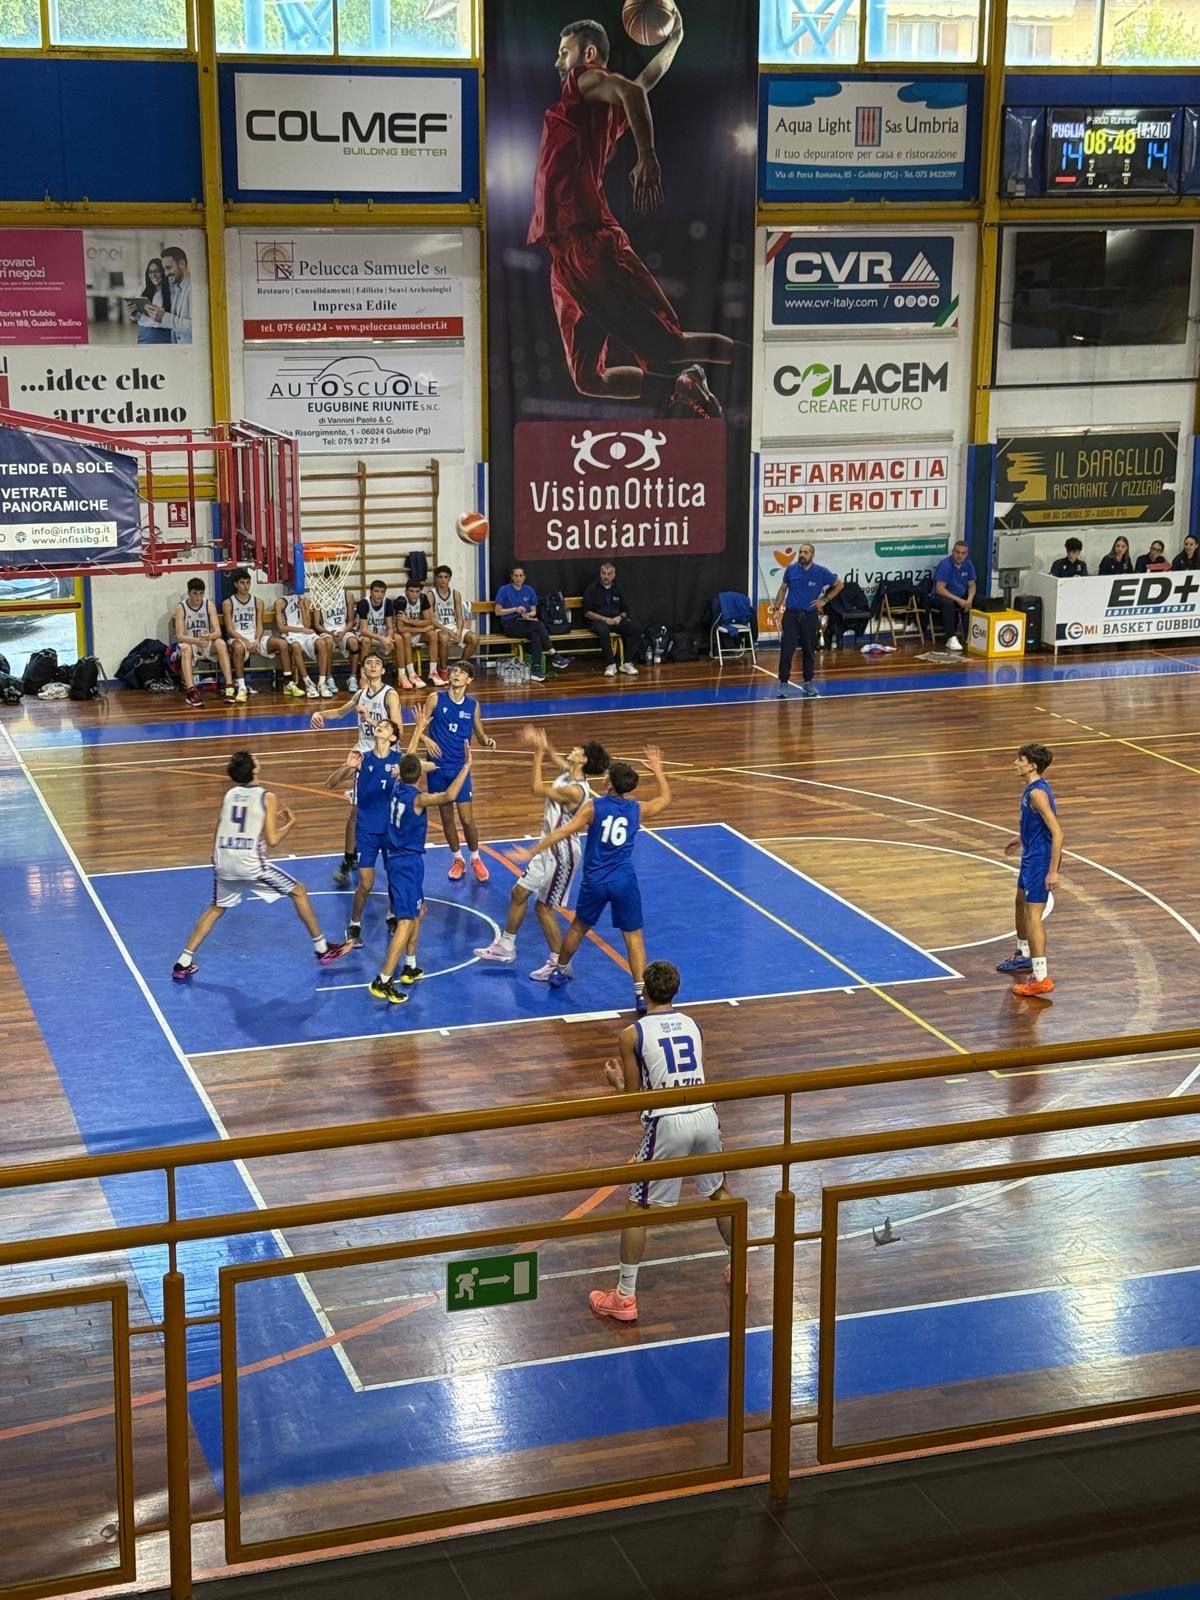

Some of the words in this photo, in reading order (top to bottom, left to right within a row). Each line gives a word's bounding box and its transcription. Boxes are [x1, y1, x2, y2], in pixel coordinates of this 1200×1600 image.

[246, 109, 447, 144] COLMEF
[775, 118, 812, 135] Aqua
[817, 117, 852, 135] Light
[885, 119, 902, 133] Sas
[906, 116, 959, 133] Umbria
[1052, 122, 1084, 138] PUGLIA
[1139, 123, 1169, 138] LAZIO
[1083, 128, 1136, 155] 08:48
[343, 147, 398, 156] BUILDING
[400, 148, 447, 157] BETTER
[784, 150, 800, 159] tuo
[803, 149, 854, 161] depuratore
[857, 151, 871, 161] per
[875, 150, 894, 159] casa
[897, 151, 902, 159] e
[905, 149, 958, 159] ristorazione
[1062, 142, 1083, 170] 14
[1147, 142, 1168, 170] 14
[775, 171, 786, 179] Via
[8, 267, 46, 281] negozi
[299, 259, 359, 276] Pelucca
[364, 259, 429, 276] Samuele
[434, 265, 447, 276] Srl
[786, 251, 893, 283] CVR
[257, 286, 290, 295] Restauro
[294, 286, 351, 295] Consolidamenti
[356, 286, 384, 295] Edilizia
[388, 286, 407, 295] Scavi
[409, 286, 452, 295] Archeologici
[29, 309, 57, 318] Gubbio
[313, 300, 362, 314] Impresa
[366, 300, 397, 312] Edile
[3, 319, 15, 328] km
[31, 319, 57, 328] Gualdo
[260, 323, 275, 333] tel.
[277, 322, 293, 333] 075
[295, 322, 327, 333] 602424
[335, 320, 448, 334] www.peluccasamuelesrl.it
[115, 367, 166, 391] che
[773, 361, 949, 397] COLACEM
[269, 379, 439, 397] AUTOSCUOLE
[53, 401, 188, 424] arredano
[307, 401, 371, 413] EUGUBINE
[373, 400, 420, 412] RIUNITE
[420, 403, 440, 412] S.N.C.
[798, 398, 857, 414] CREARE
[862, 397, 923, 412] FUTURO
[319, 417, 326, 425] di
[327, 416, 355, 425] Vannini
[357, 416, 377, 424] Paolo
[378, 416, 385, 424] &
[295, 427, 349, 438] Risorgimento,
[361, 427, 385, 437] 06024
[386, 426, 414, 436] Gubbio
[415, 426, 431, 437] (Pg)
[338, 437, 353, 446] 075
[354, 437, 369, 446] 927
[370, 436, 380, 445] 21
[381, 436, 391, 445] 54
[1, 462, 49, 475] TENDE
[52, 462, 73, 474] DA
[76, 461, 114, 474] SOLE
[1055, 451, 1069, 480] IL
[1077, 447, 1165, 479] BARGELLO
[789, 459, 945, 484] FARMACIA
[1, 486, 67, 499] VETRATE
[530, 477, 706, 513] VisionOttica
[1053, 481, 1108, 500] RISTORANTE
[1121, 479, 1162, 497] PIZZERIA
[2, 500, 109, 513] PANORAMICHE
[764, 499, 784, 514] Dr.
[787, 489, 939, 514] PIEROTTI
[31, 526, 111, 536] info@infissibg.it
[546, 516, 689, 551] Salciarini
[32, 535, 110, 545] www.infissibg.it
[844, 568, 859, 584] di
[864, 570, 933, 584] vacanza
[1107, 575, 1200, 608] ED+
[1106, 607, 1154, 617] EDILIZIA
[1159, 605, 1192, 614] STORE
[240, 623, 249, 631] 15
[333, 617, 342, 626] 12
[1103, 621, 1153, 635] BASKET
[1156, 617, 1200, 632] GUBBIO
[448, 722, 459, 733] 13
[380, 779, 387, 790] 7
[231, 806, 248, 833] 4
[601, 815, 628, 846] 16
[219, 835, 255, 850] LAZIO
[657, 1035, 698, 1074] 13
